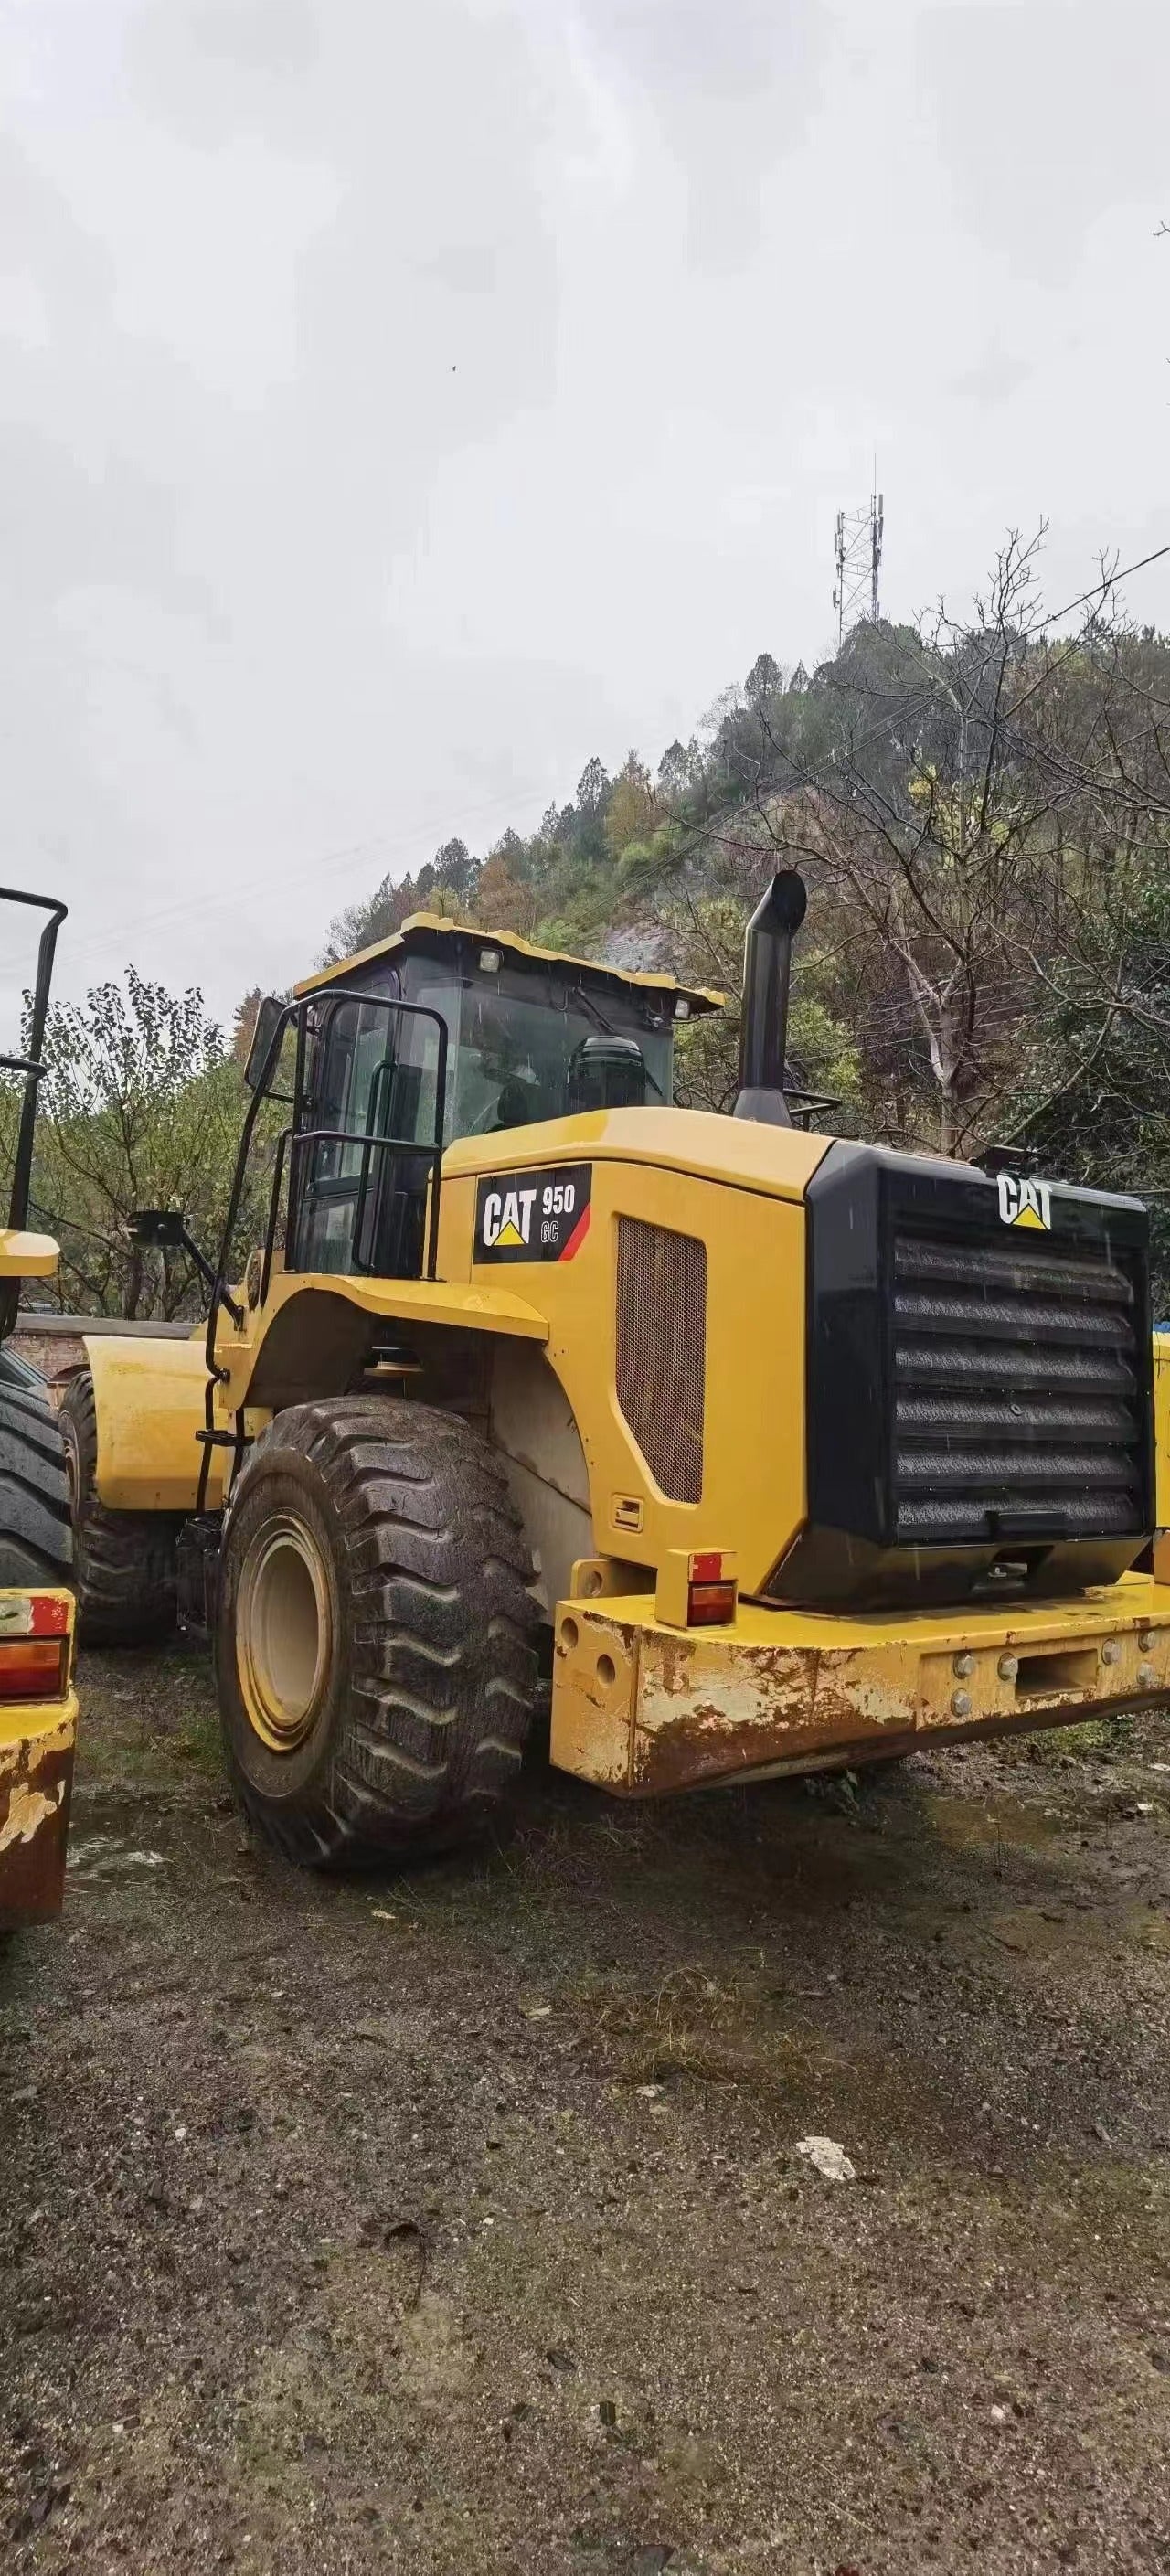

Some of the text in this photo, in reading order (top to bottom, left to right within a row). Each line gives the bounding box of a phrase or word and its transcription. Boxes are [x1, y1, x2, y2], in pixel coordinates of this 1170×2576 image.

[483, 1184, 575, 1246] CAT 950
[996, 1174, 1052, 1230] CAT
[540, 1221, 558, 1242] GC
